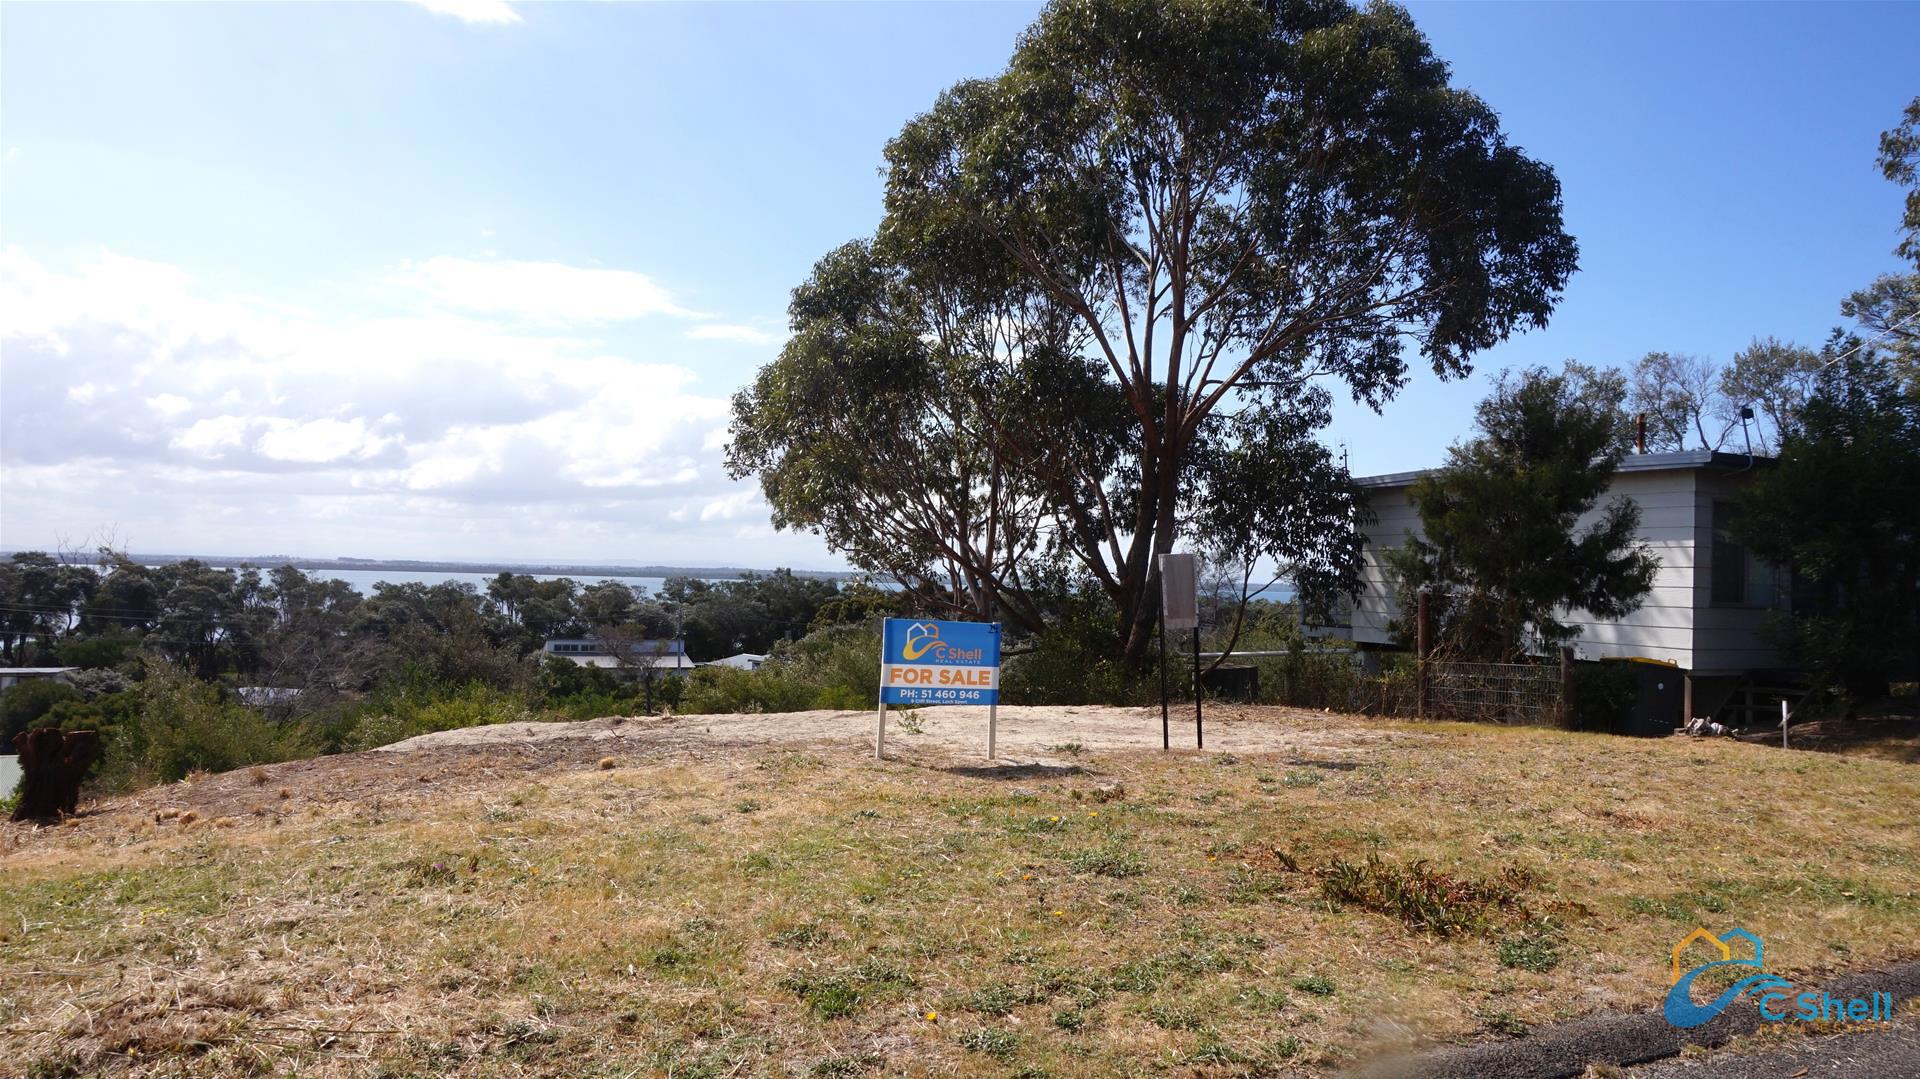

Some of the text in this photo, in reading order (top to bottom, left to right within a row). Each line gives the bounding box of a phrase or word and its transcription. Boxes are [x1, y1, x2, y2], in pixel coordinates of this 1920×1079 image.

[936, 648, 982, 659] C Shell
[890, 668, 991, 686] FOR SALE
[900, 689, 980, 699] PH: 51 460 946
